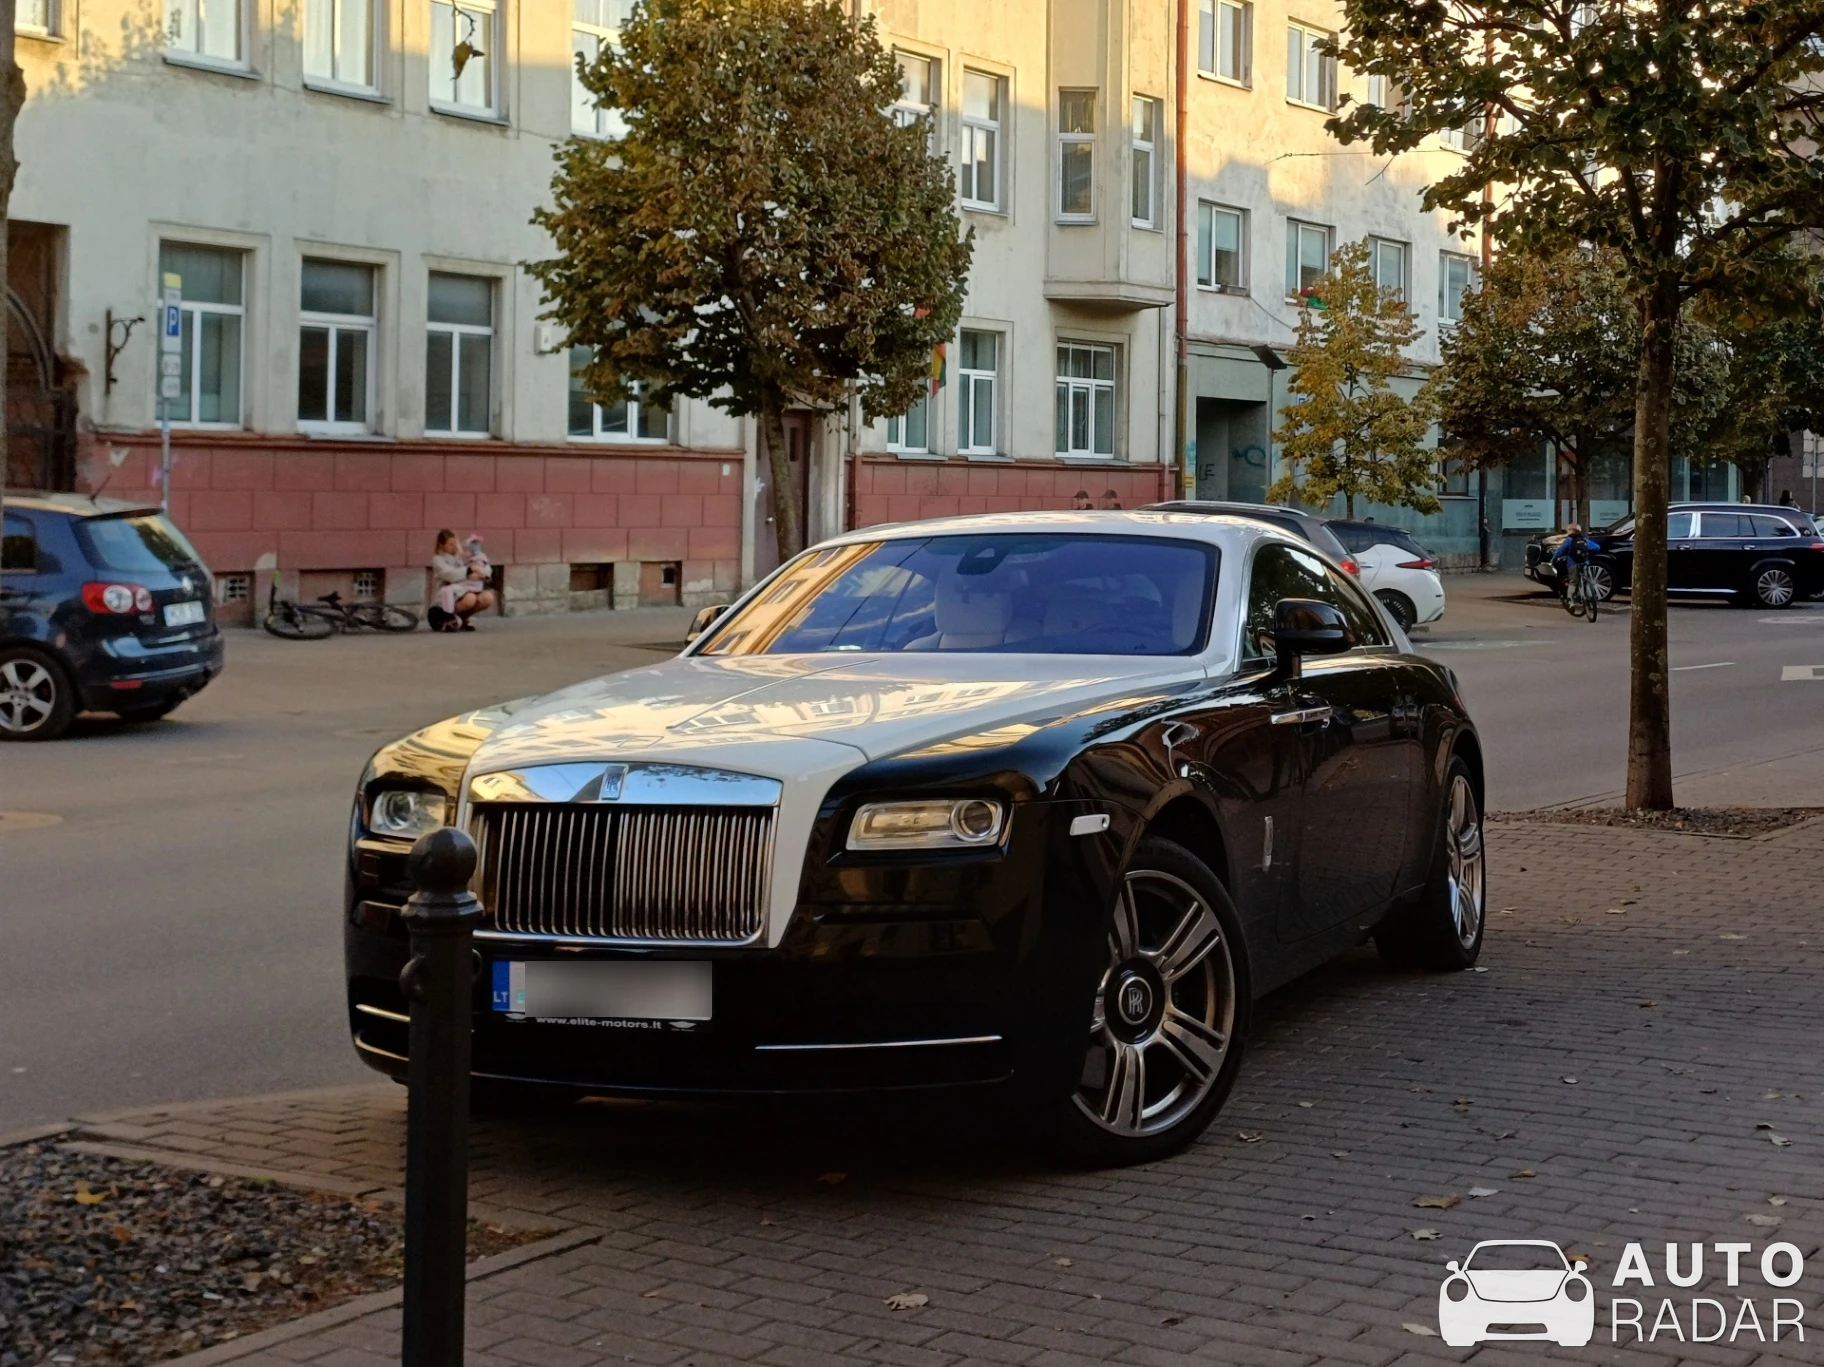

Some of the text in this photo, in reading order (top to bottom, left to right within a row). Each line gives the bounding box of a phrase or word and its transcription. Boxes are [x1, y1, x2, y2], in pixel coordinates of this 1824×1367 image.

[168, 308, 178, 335] P
[494, 991, 509, 1003] LT
[535, 1016, 662, 1030] www.elite-motors.lt
